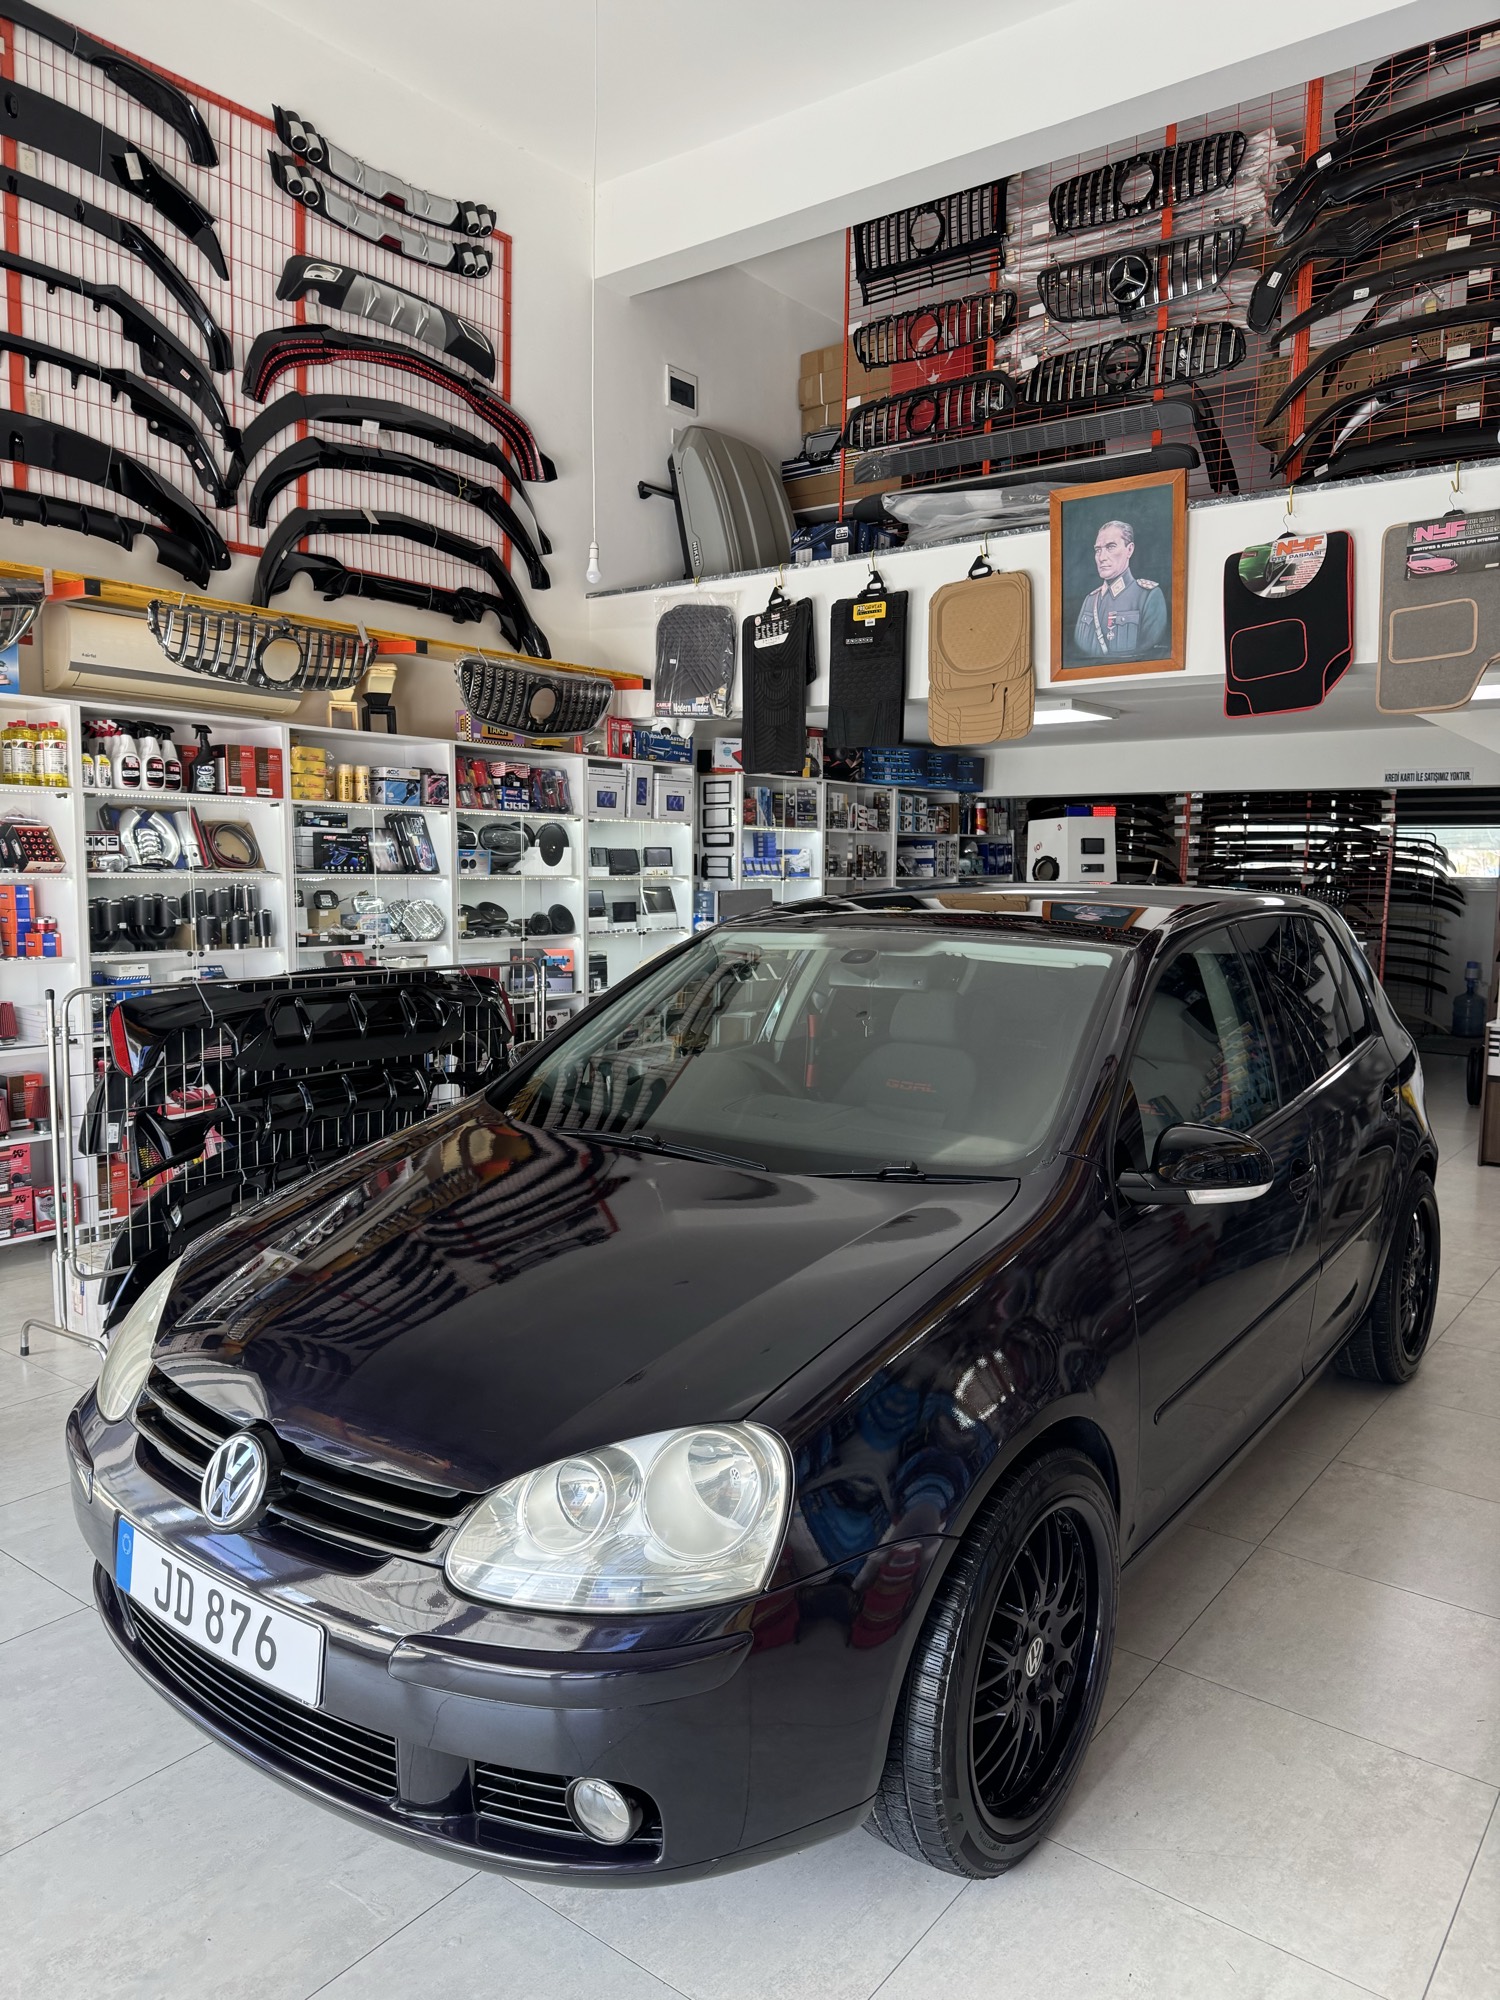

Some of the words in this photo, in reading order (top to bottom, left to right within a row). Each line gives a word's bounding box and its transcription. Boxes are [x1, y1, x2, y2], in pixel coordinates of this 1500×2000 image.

[1416, 520, 1467, 543] NYF
[1275, 535, 1325, 557] NYF
[1384, 771, 1400, 783] KREDİ
[1400, 772, 1415, 782] KARTI
[153, 1557, 195, 1627] JD
[204, 1588, 278, 1672] 876
